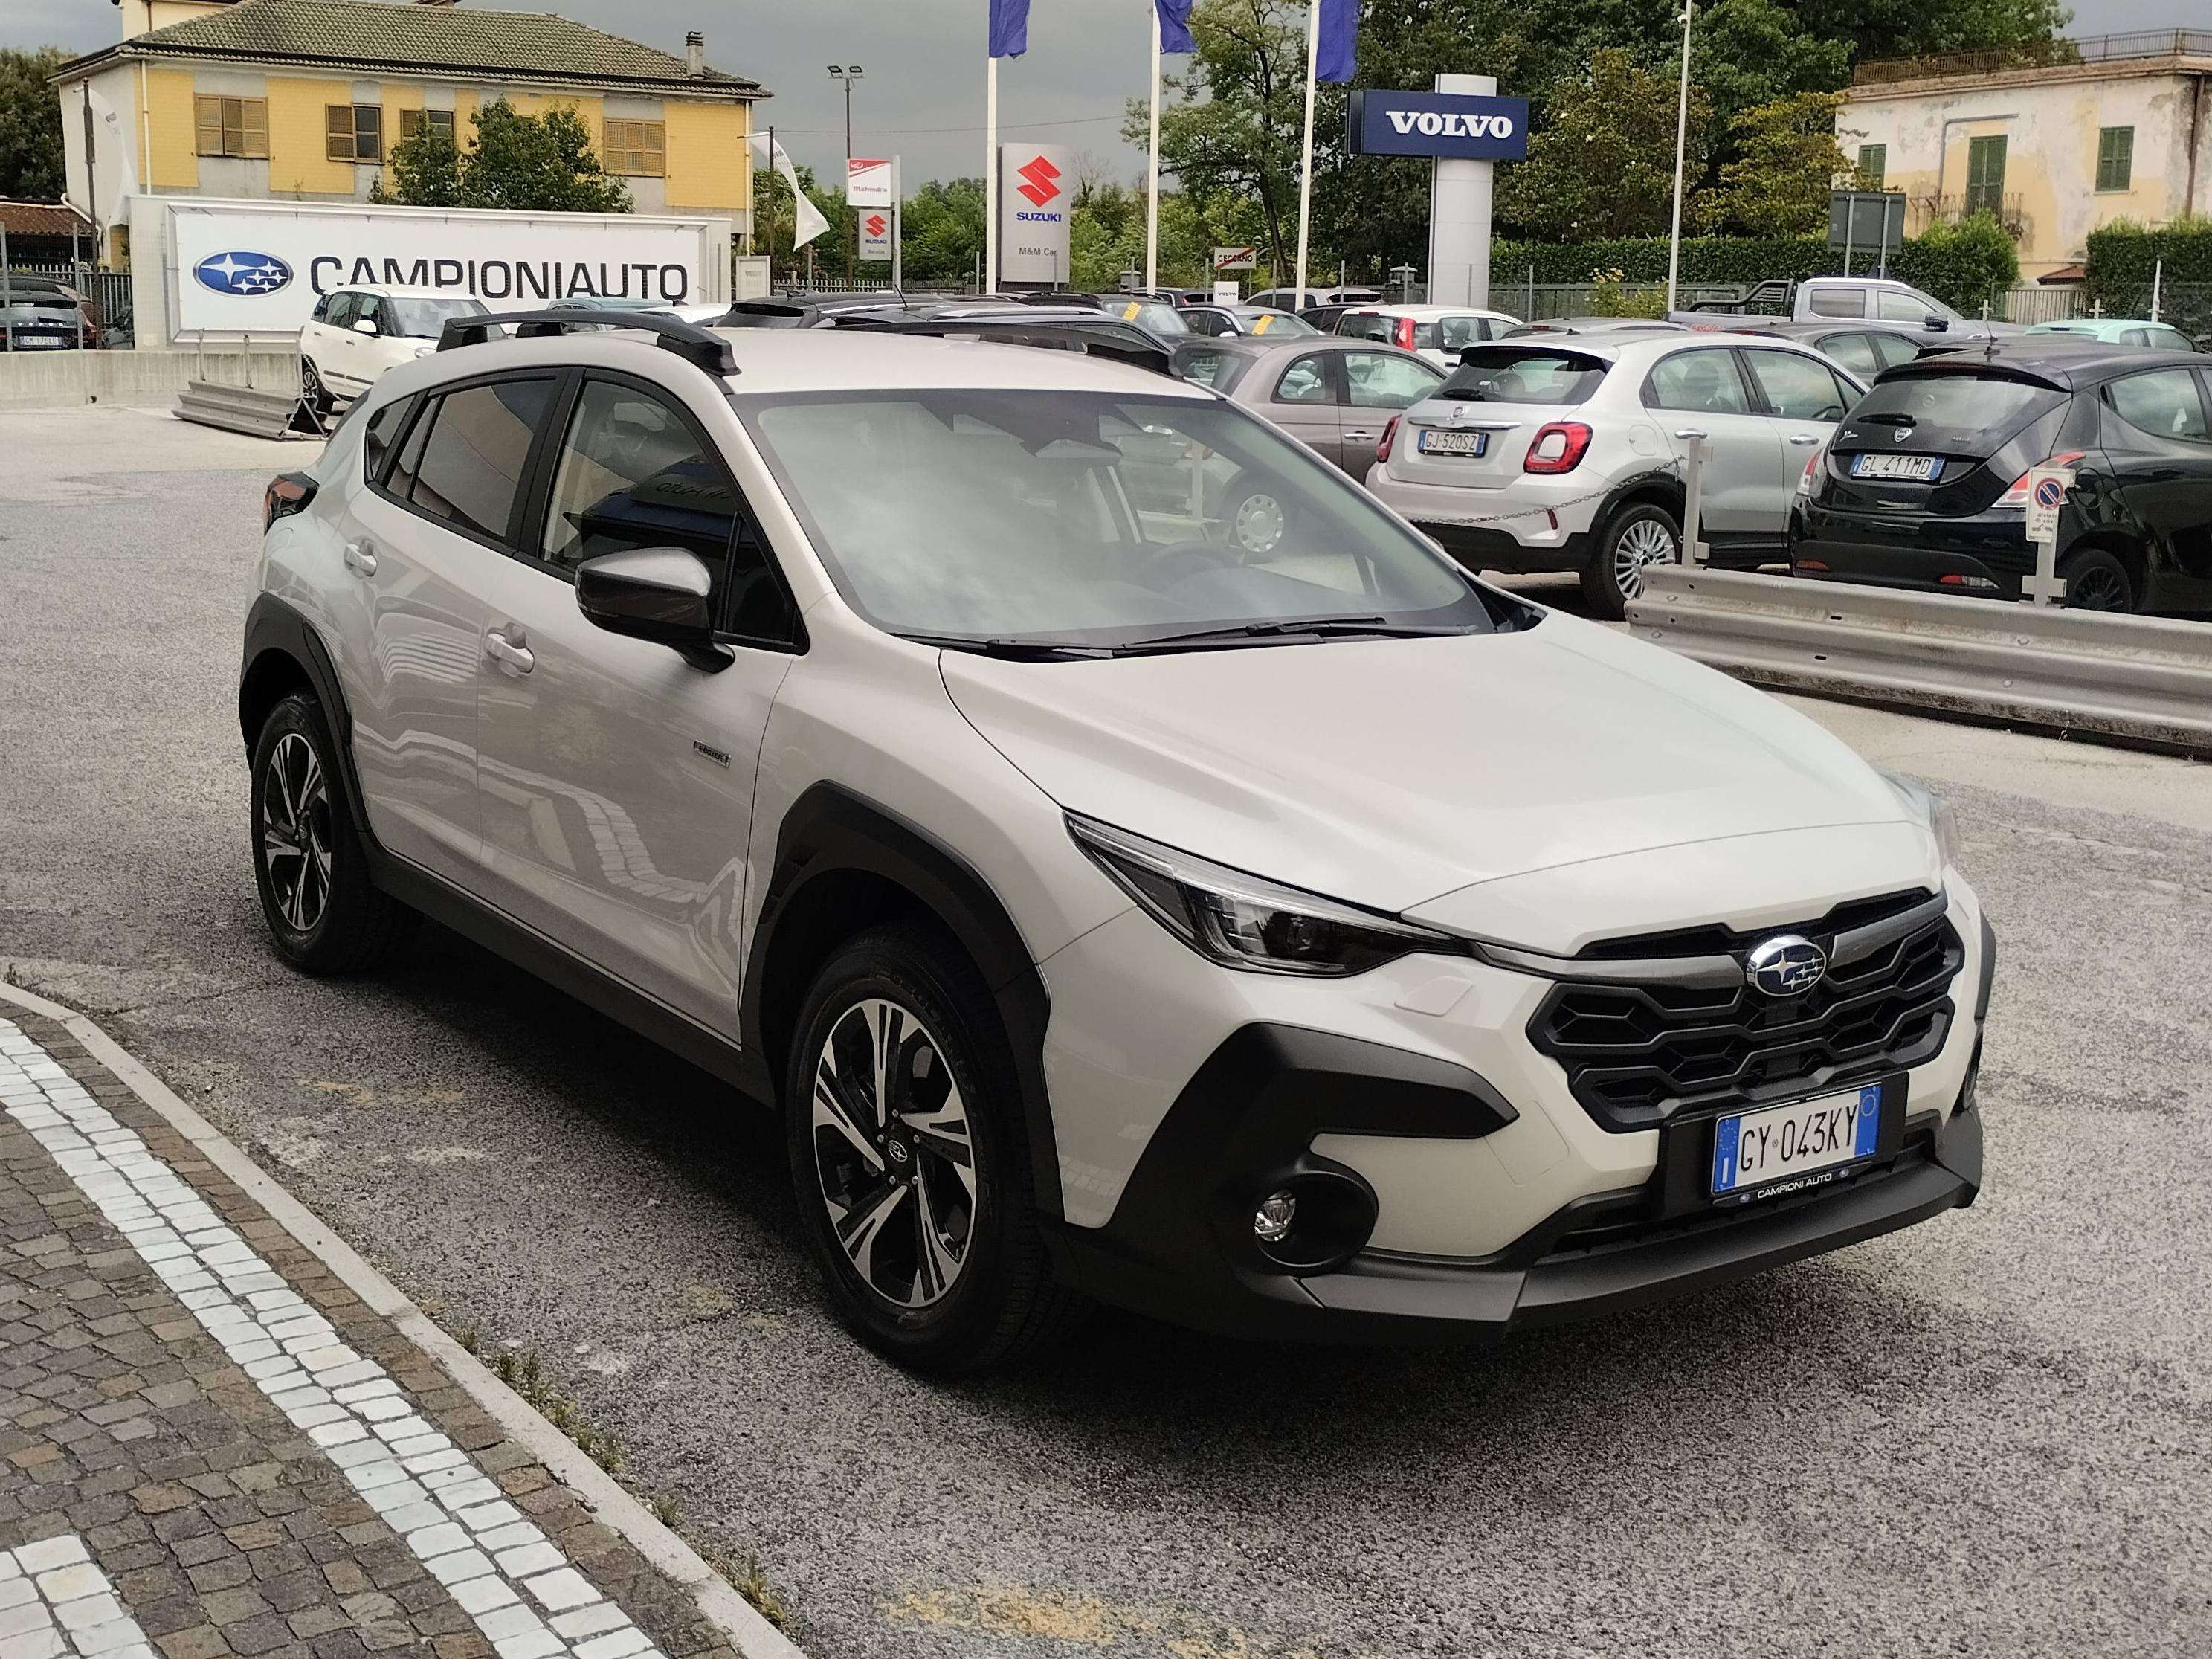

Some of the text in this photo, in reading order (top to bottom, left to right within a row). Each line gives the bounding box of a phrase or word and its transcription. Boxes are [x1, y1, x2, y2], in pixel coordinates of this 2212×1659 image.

[1386, 111, 1512, 139] VOLVO
[1016, 212, 1062, 222] SUZUKI
[1019, 247, 1041, 255] M&M
[1426, 433, 1439, 448] GJ
[1442, 434, 1477, 451] 520SZ
[1861, 456, 1876, 471] GL
[1883, 457, 1932, 474] 411MD
[1740, 1124, 1772, 1172] GY
[1781, 1104, 1858, 1162] 043KY
[1757, 1173, 1832, 1199] CAMPIONI AUTO
